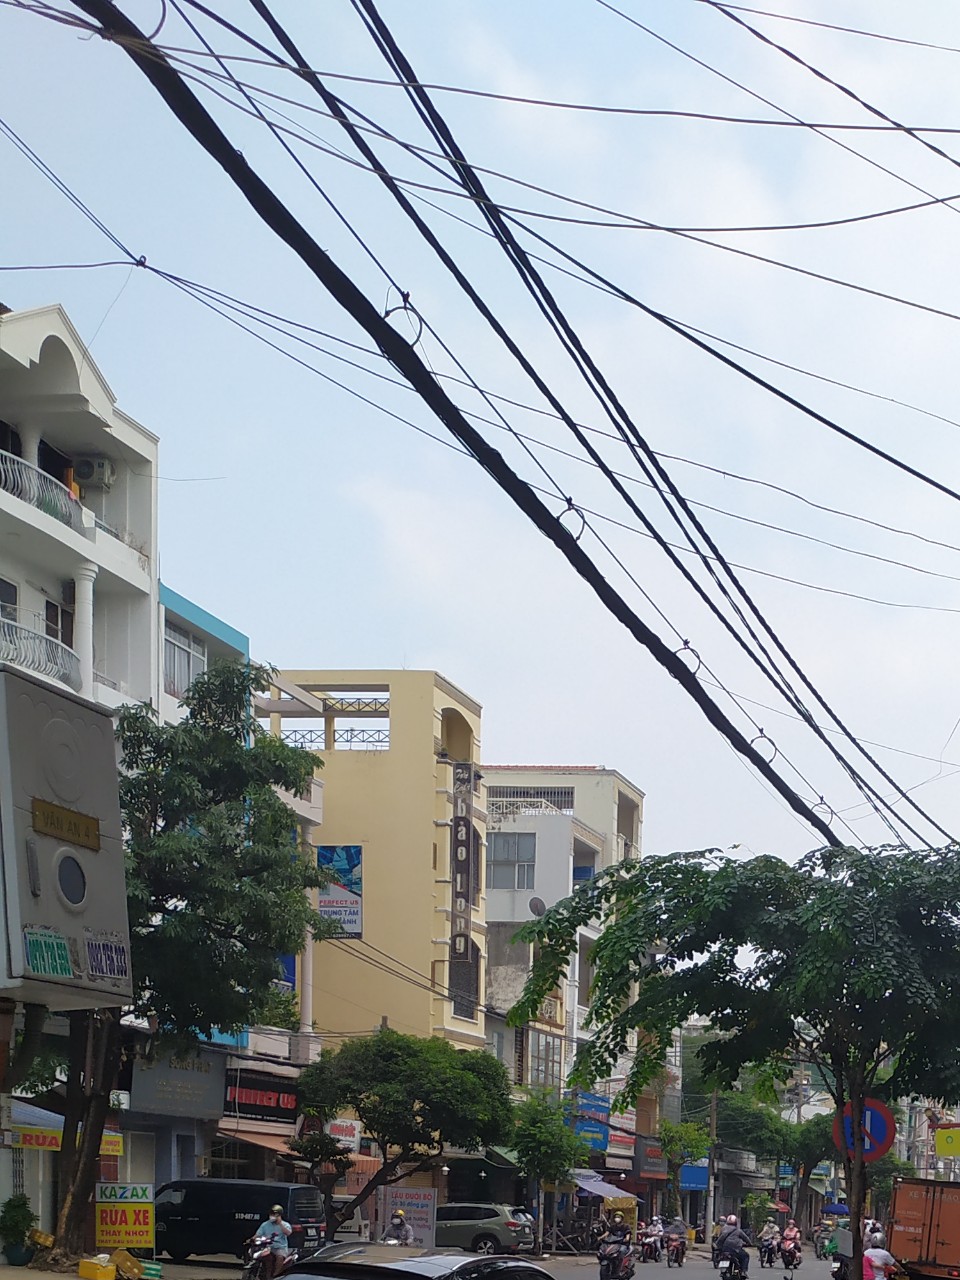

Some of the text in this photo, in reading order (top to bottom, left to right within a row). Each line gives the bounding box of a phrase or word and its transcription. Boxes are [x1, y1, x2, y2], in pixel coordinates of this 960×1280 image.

[319, 909, 359, 917] TRUNG TÂM
[227, 1086, 279, 1107] PERFECT
[280, 1093, 297, 1109] US
[22, 1132, 60, 1148] RỬA
[100, 1186, 149, 1200] KAZAX
[100, 1205, 150, 1226] RỬA XE
